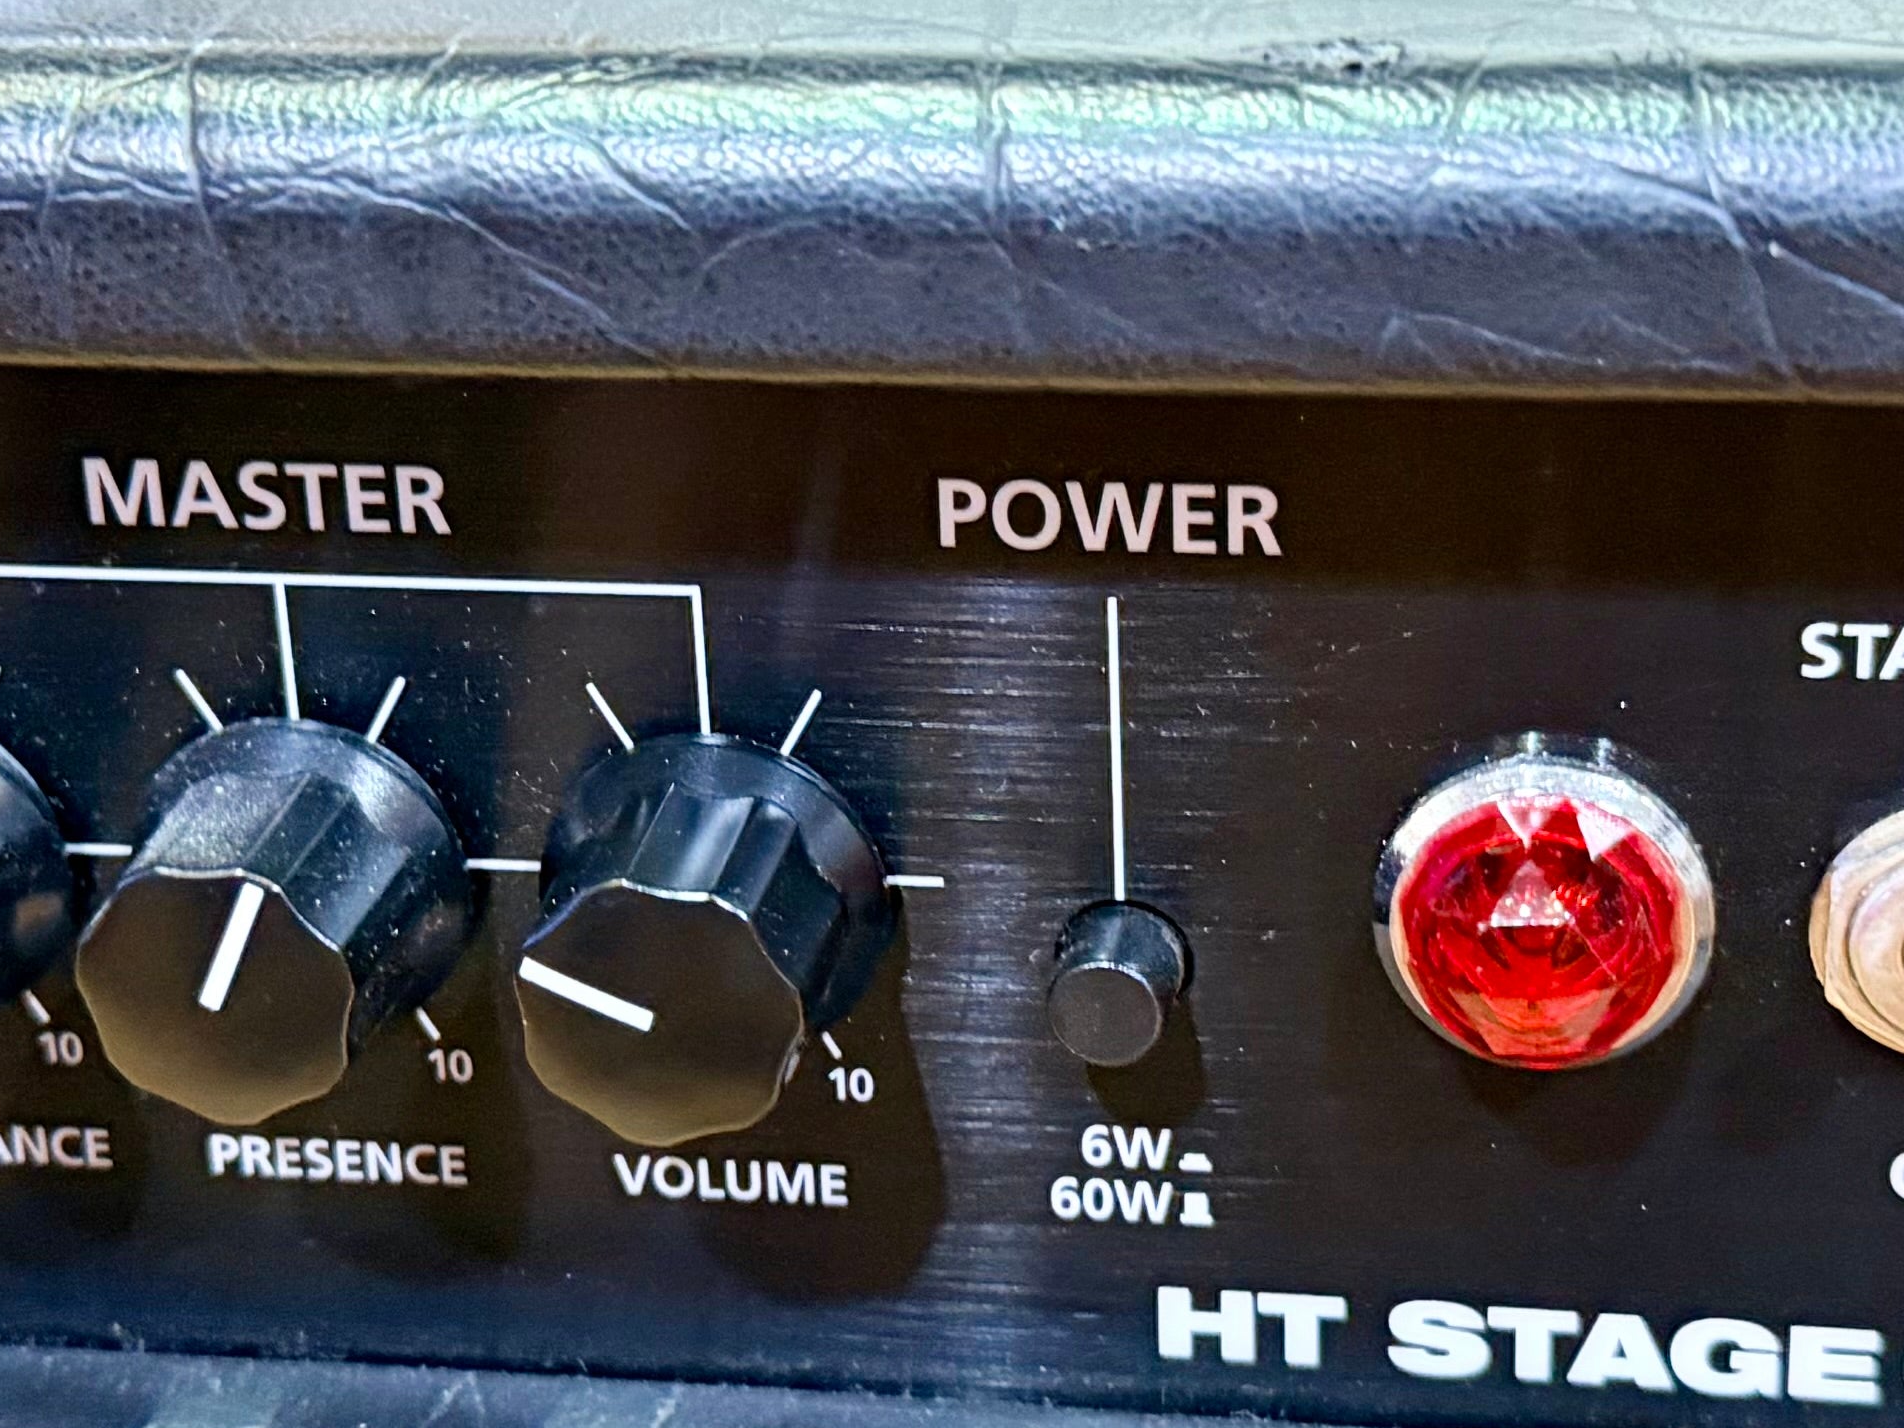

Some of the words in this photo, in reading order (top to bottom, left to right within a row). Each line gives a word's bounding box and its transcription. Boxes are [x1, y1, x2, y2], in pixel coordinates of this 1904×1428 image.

[84, 458, 451, 534] MASTER
[938, 479, 1281, 555] POWER
[39, 1032, 83, 1064] 10
[428, 1049, 472, 1082] 10
[829, 1068, 873, 1102] 10
[209, 1134, 467, 1184] PRESENCE
[1082, 1124, 1171, 1169] 6W
[614, 1154, 848, 1206] VOLUME
[1051, 1176, 1173, 1223] 60W
[1158, 1286, 1347, 1368] HT
[1388, 1300, 1883, 1405] STAGE
